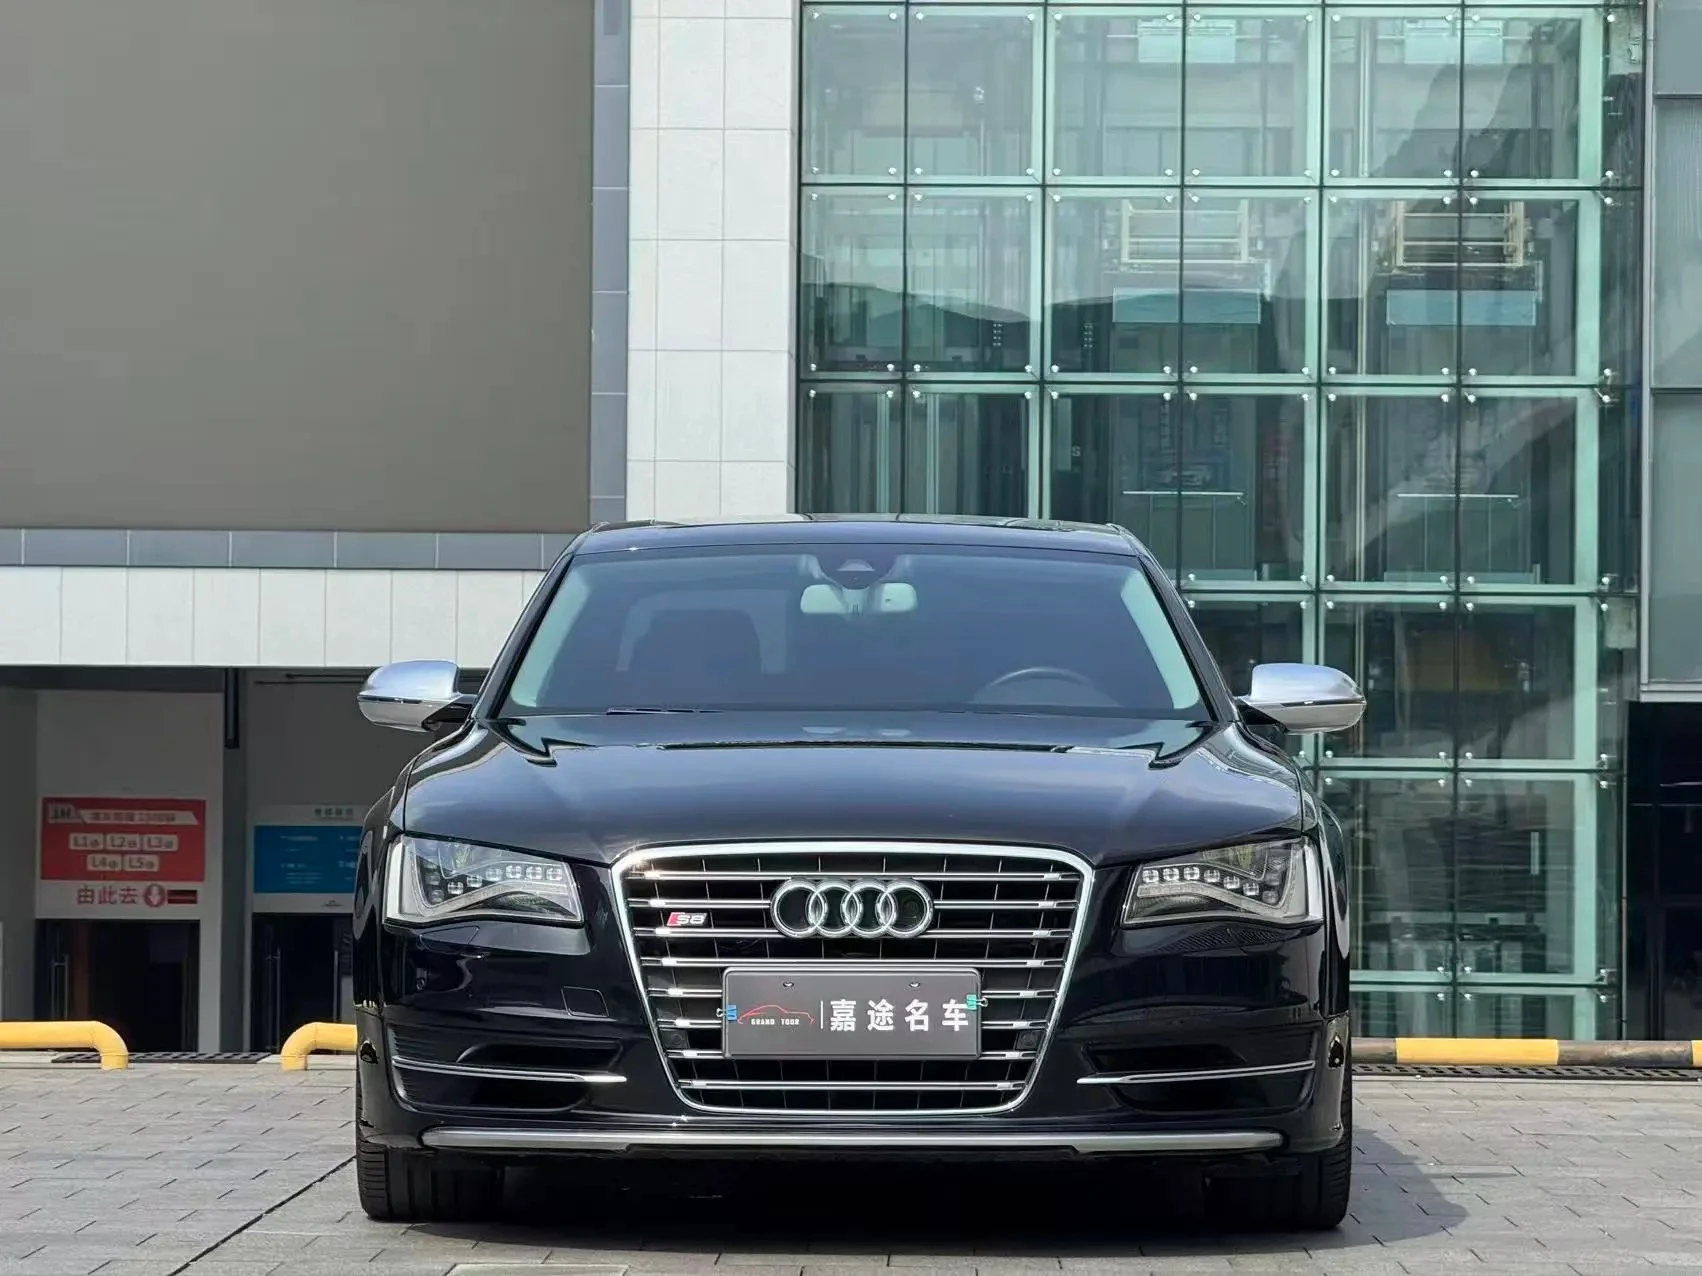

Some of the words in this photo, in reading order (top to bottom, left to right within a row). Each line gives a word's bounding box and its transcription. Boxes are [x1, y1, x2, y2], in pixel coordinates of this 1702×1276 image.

[77, 885, 137, 904] 由此去
[676, 914, 705, 925] S8
[751, 1018, 775, 1026] GRAND
[781, 1018, 800, 1026] TOUR
[830, 999, 969, 1032] 嘉途名车
